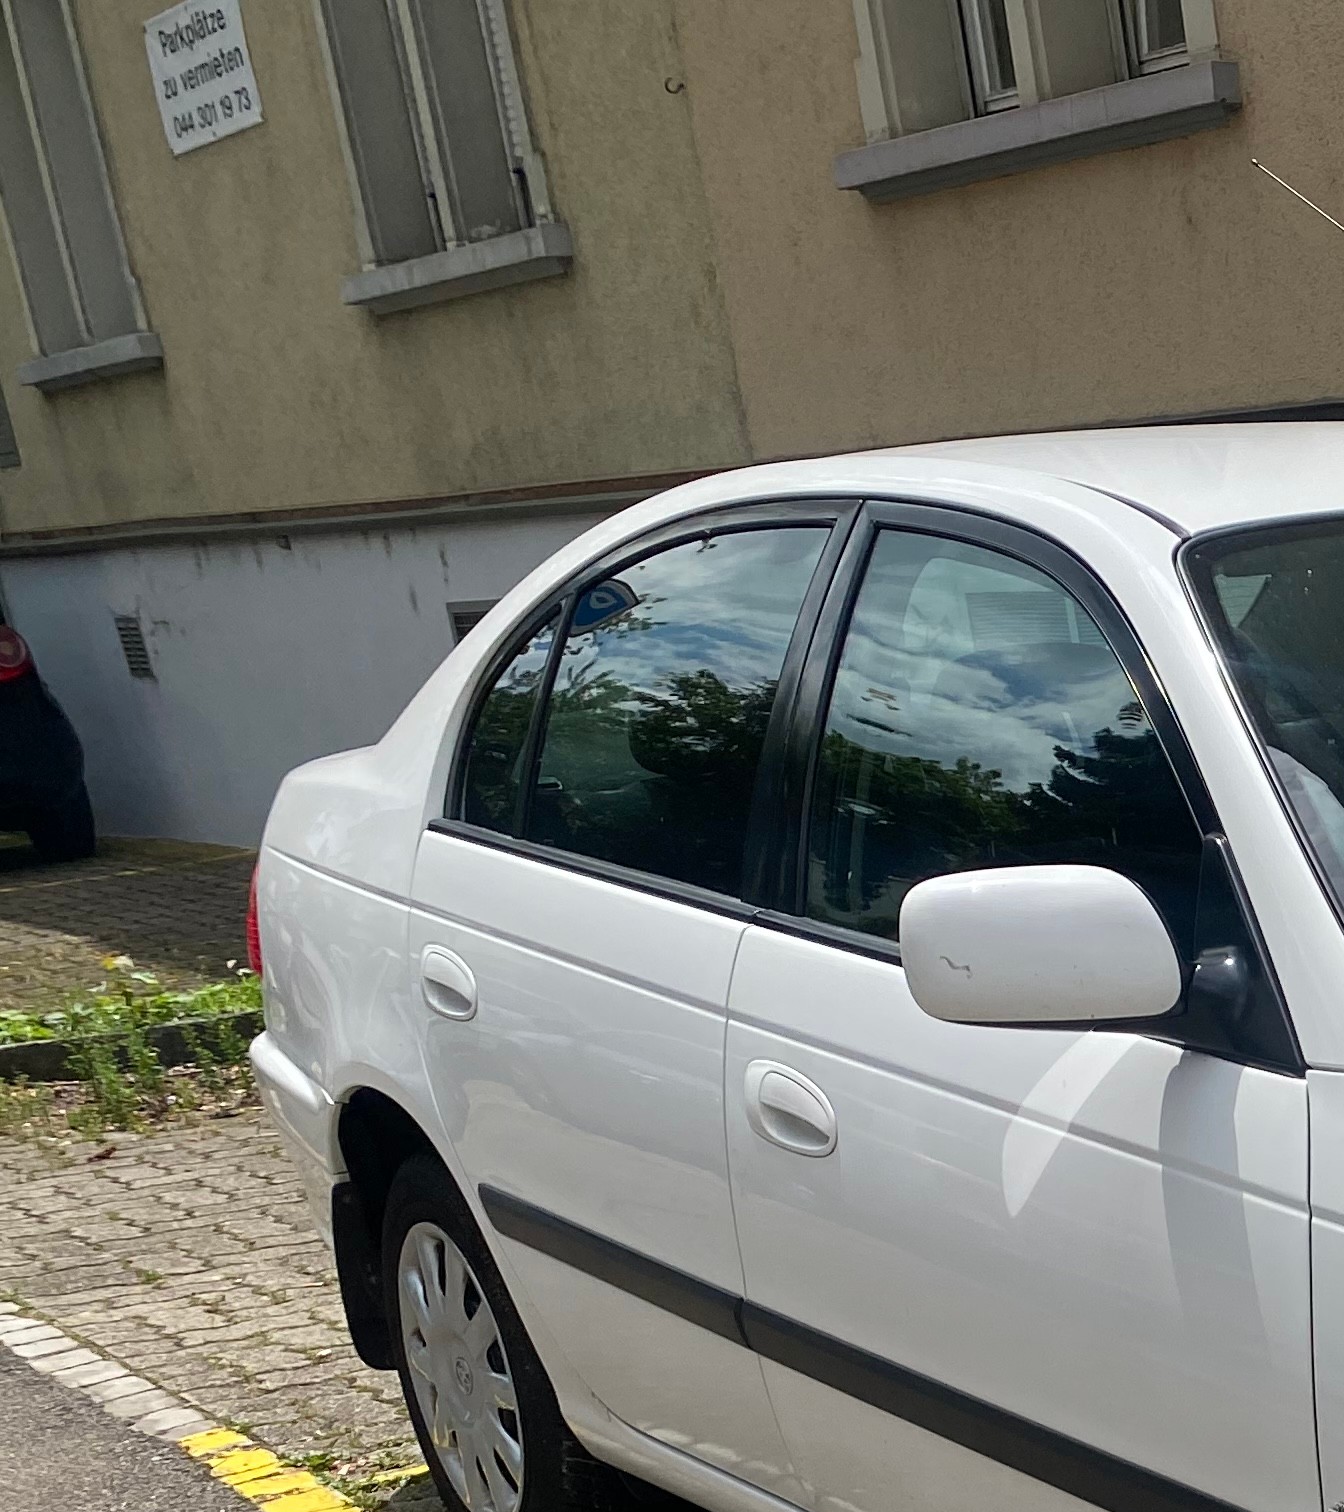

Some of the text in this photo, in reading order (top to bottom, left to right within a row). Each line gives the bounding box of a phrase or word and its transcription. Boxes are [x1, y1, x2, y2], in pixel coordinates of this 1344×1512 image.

[158, 9, 227, 57] Parkplätze
[162, 46, 245, 100] zu vermieten
[173, 87, 252, 138] 044 301 19 73
